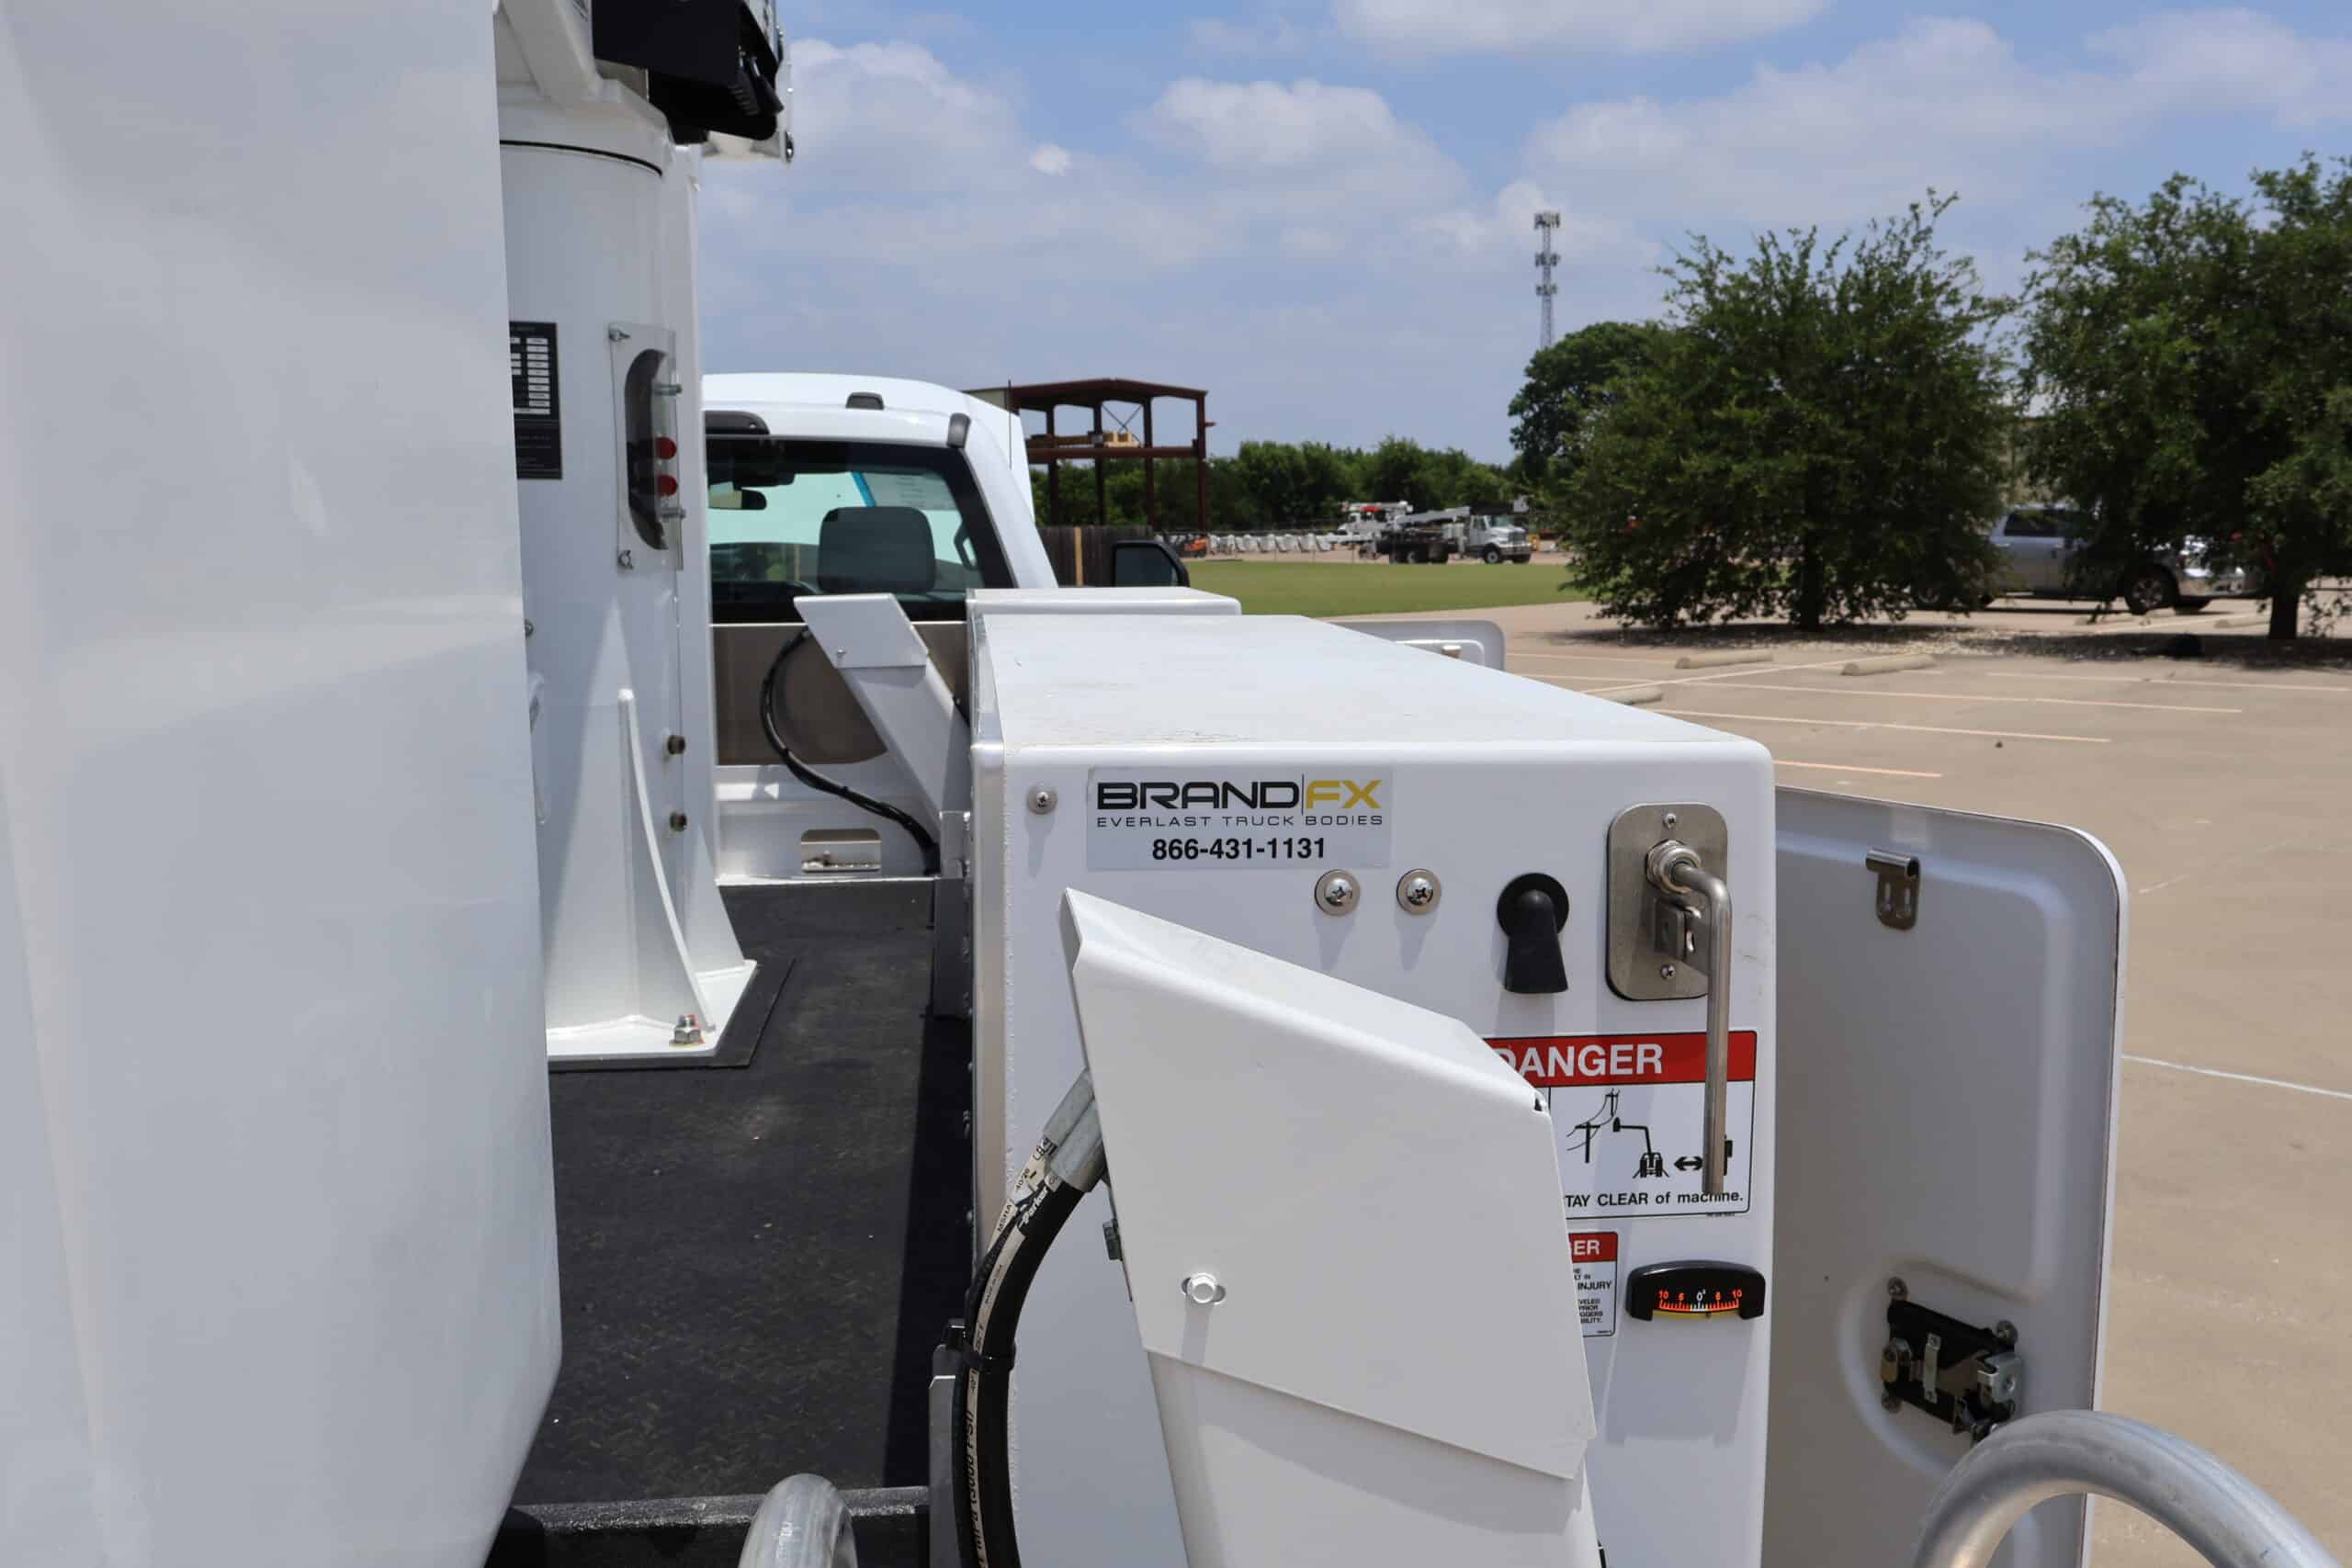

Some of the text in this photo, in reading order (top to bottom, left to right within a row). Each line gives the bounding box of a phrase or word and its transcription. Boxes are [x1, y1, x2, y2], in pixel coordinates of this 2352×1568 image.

[1097, 780, 1382, 809] BRAND FX
[1097, 816, 1383, 828] EVERLAST TRUCK BODIES
[1152, 838, 1325, 860] 866-431-1131
[1565, 1194, 1590, 1208] TAY
[1597, 1192, 1648, 1206] CLEAR
[1655, 1191, 1671, 1204] of
[1577, 1280, 1612, 1291] INJURY
[1659, 1290, 1669, 1300] 10
[1733, 1289, 1743, 1299] 10
